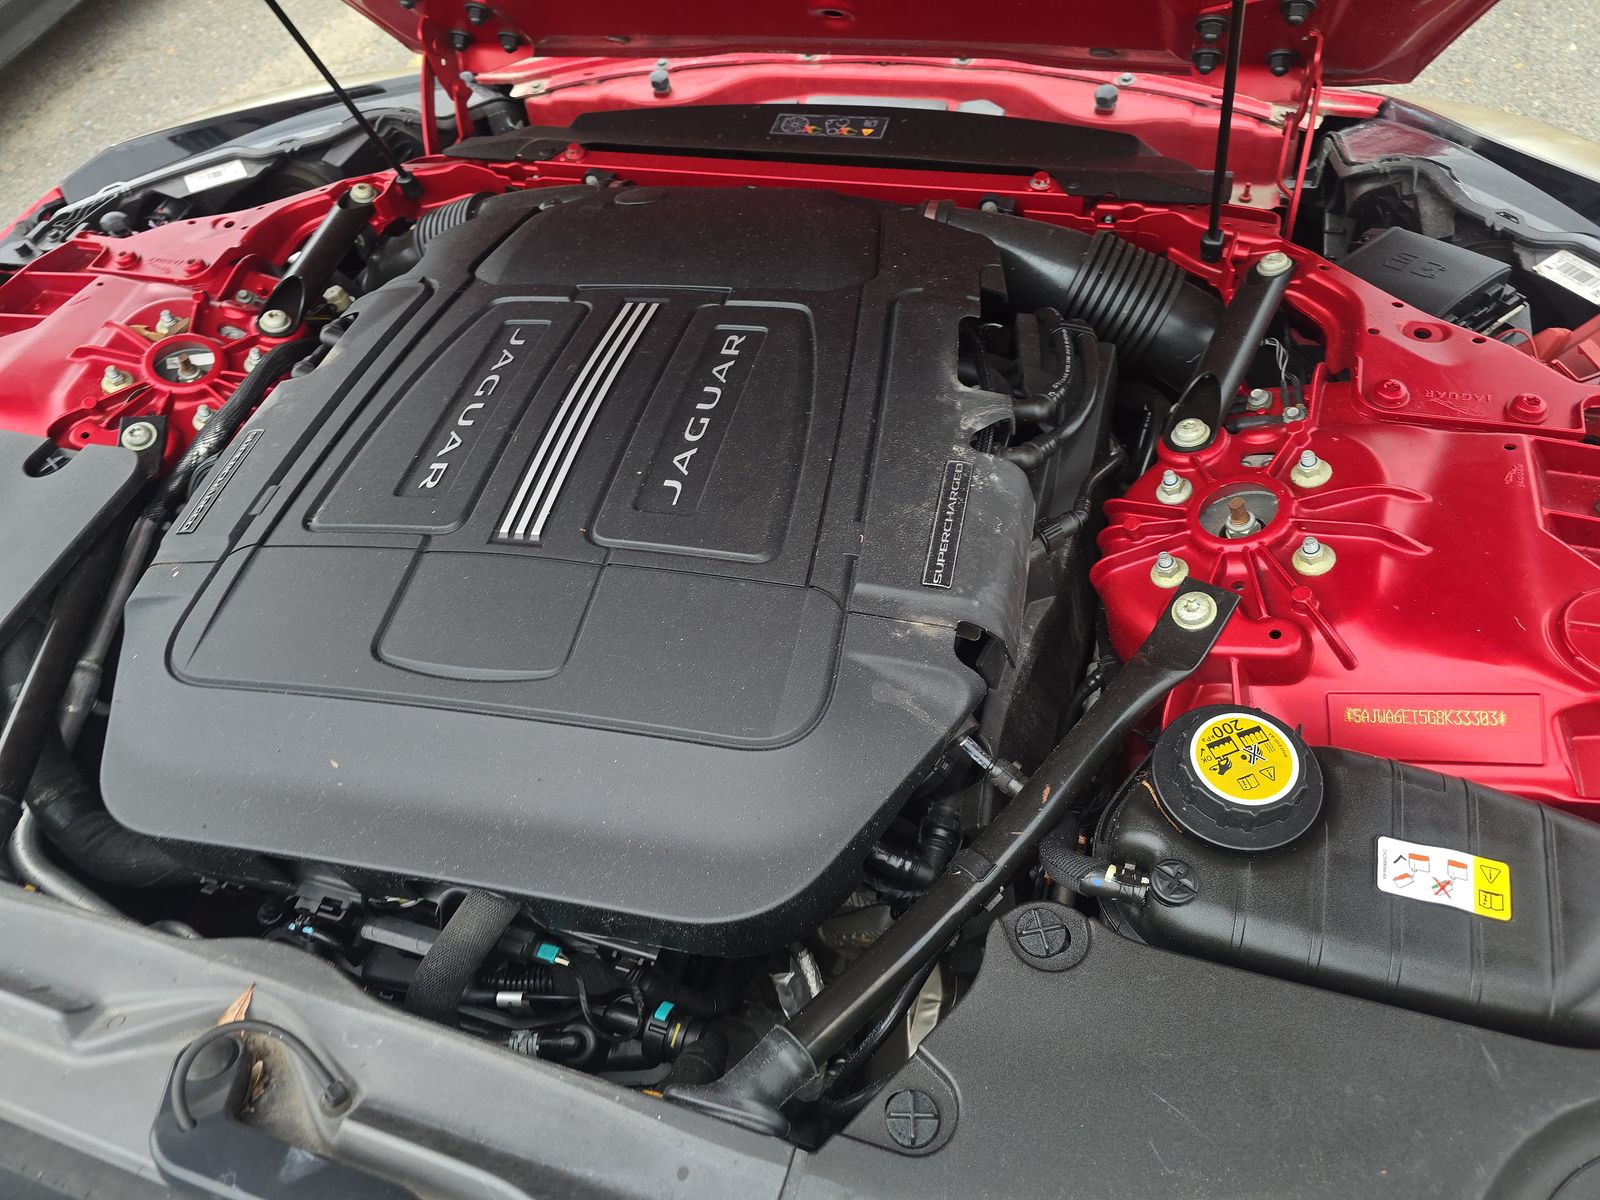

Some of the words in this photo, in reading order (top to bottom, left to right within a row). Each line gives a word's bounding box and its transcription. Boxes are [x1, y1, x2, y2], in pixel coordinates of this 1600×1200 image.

[418, 327, 526, 489] JAGUAR
[663, 334, 747, 506] JAGUAR
[1424, 389, 1492, 402] JAGUAR
[932, 462, 964, 584] SUPERCHARGED
[1200, 755, 1213, 764] OK
[1211, 719, 1244, 738] 200
